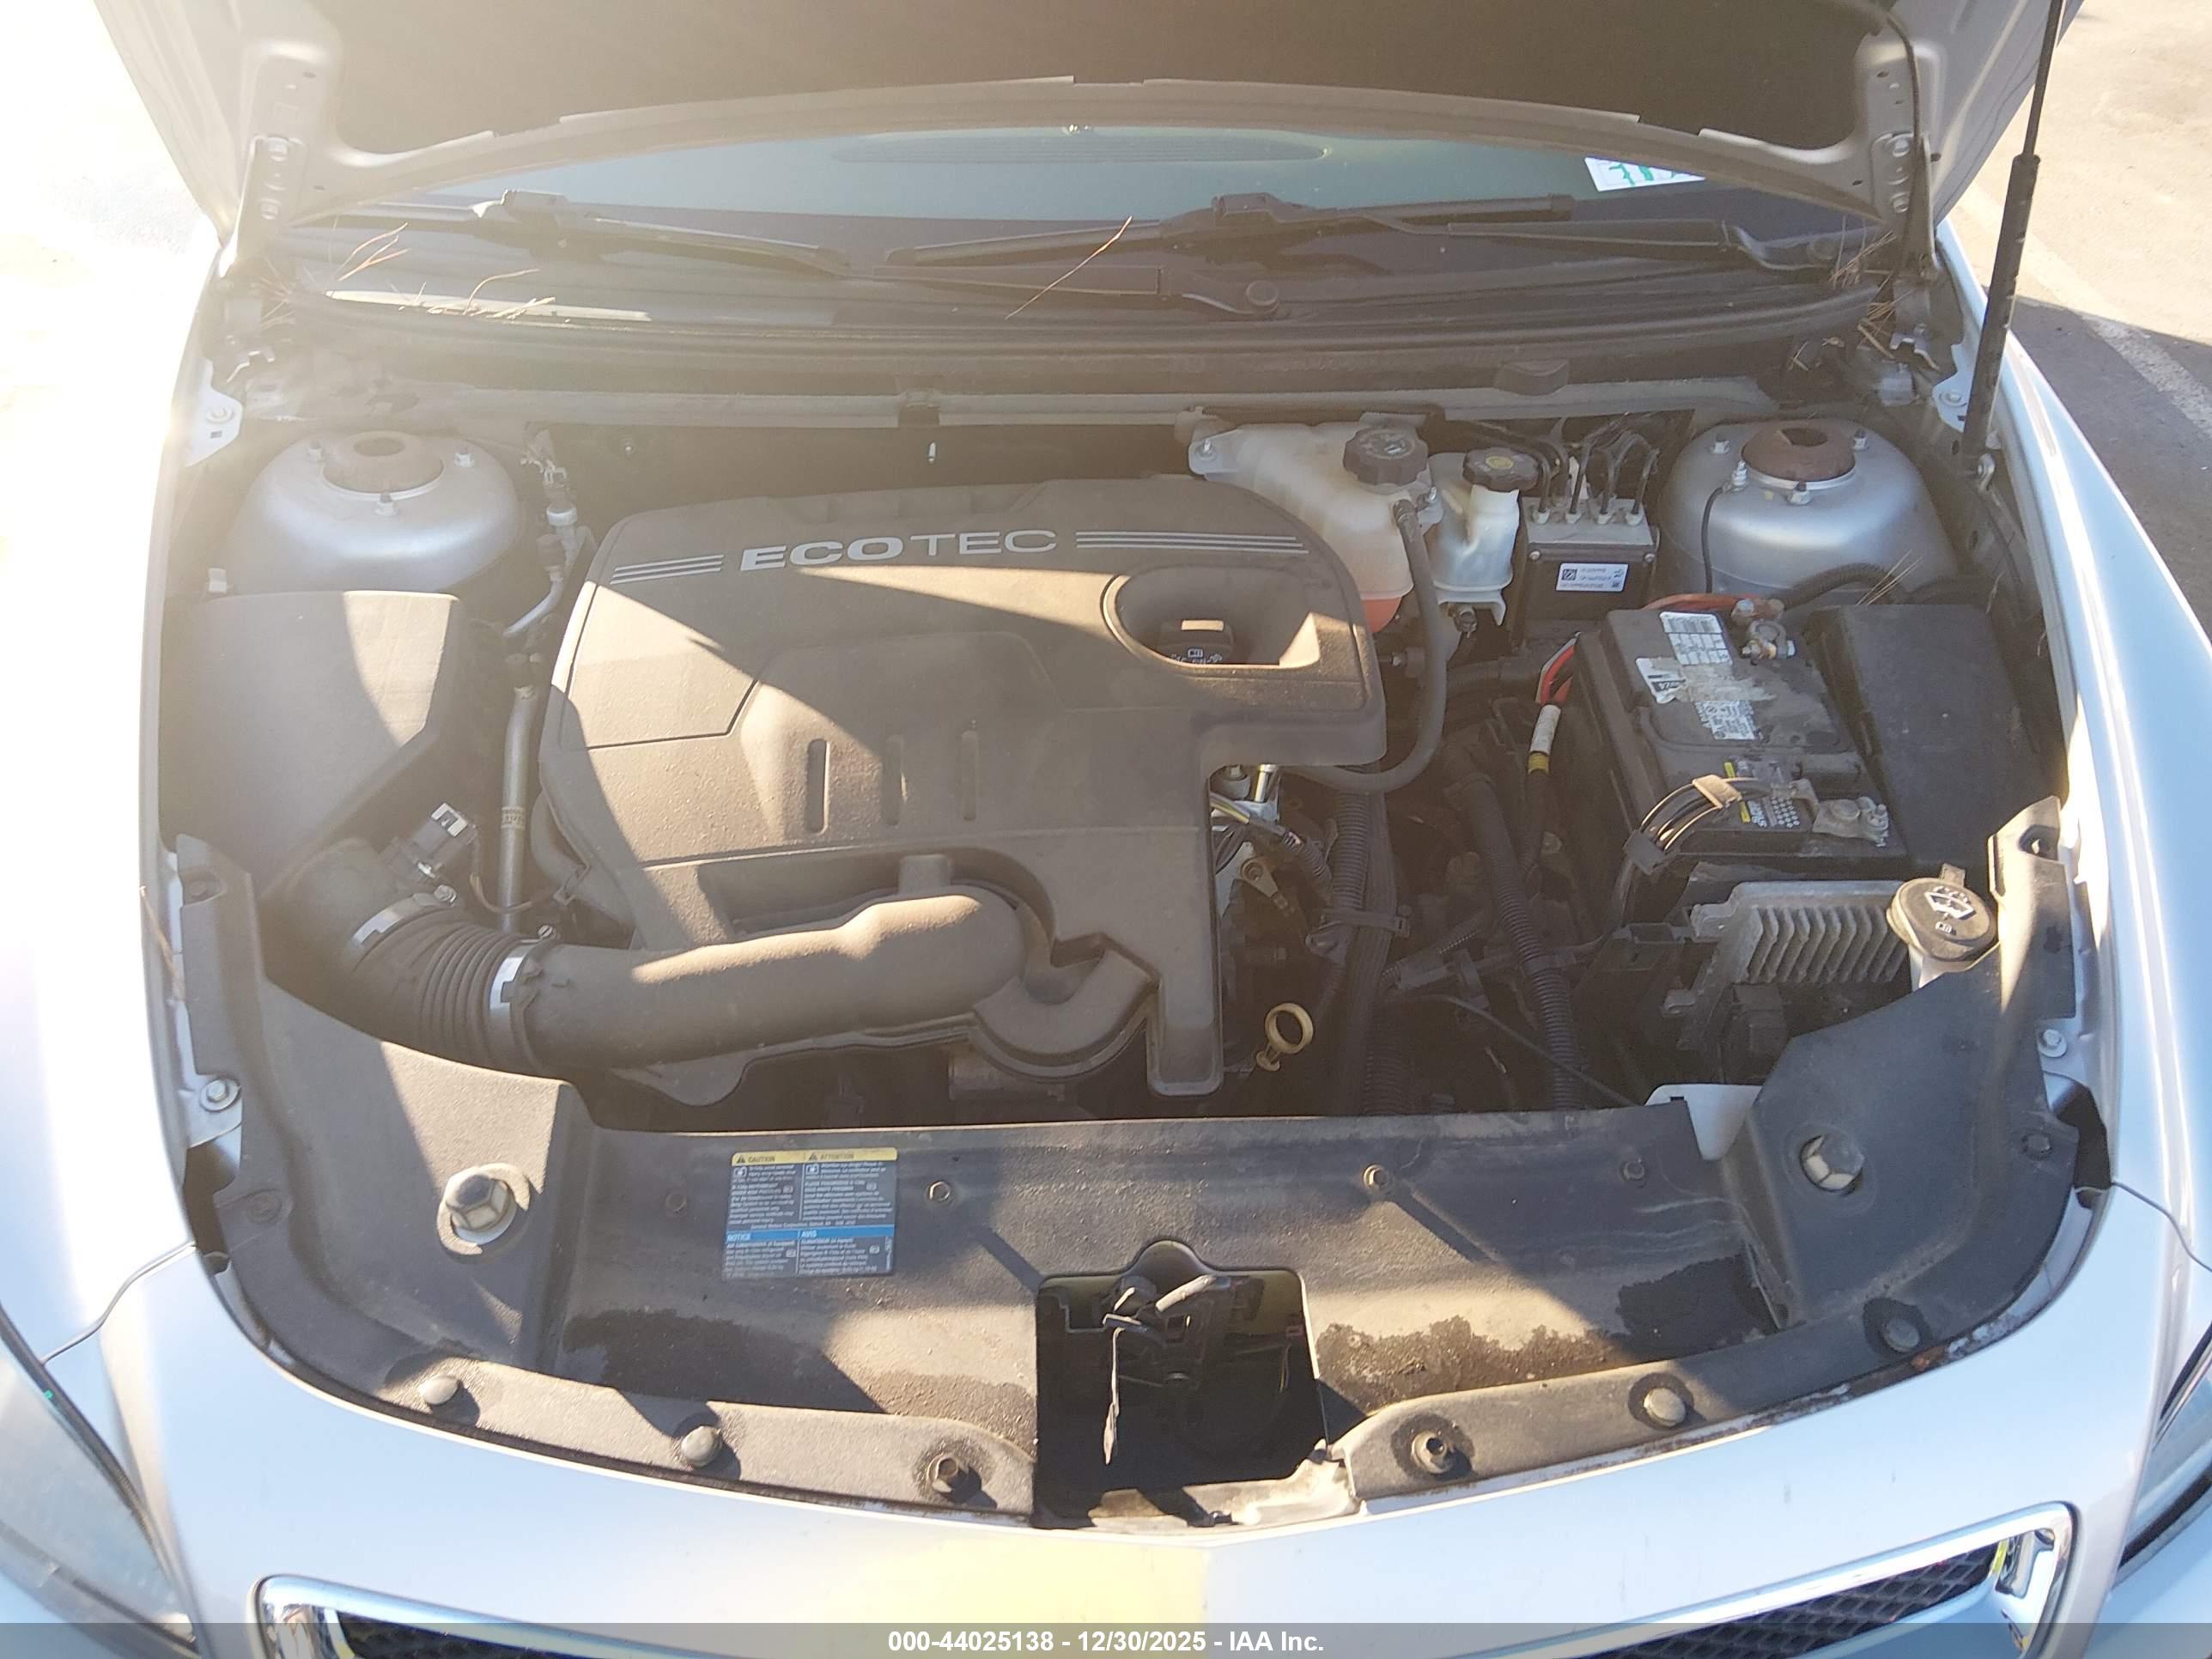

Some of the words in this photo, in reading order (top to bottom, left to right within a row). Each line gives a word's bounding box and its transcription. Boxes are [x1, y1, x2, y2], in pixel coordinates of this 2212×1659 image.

[740, 530, 1057, 571] ECOTEC
[748, 1155, 776, 1164] CAUTION
[726, 1232, 751, 1243] NOTICE
[801, 1229, 817, 1238] AVIS
